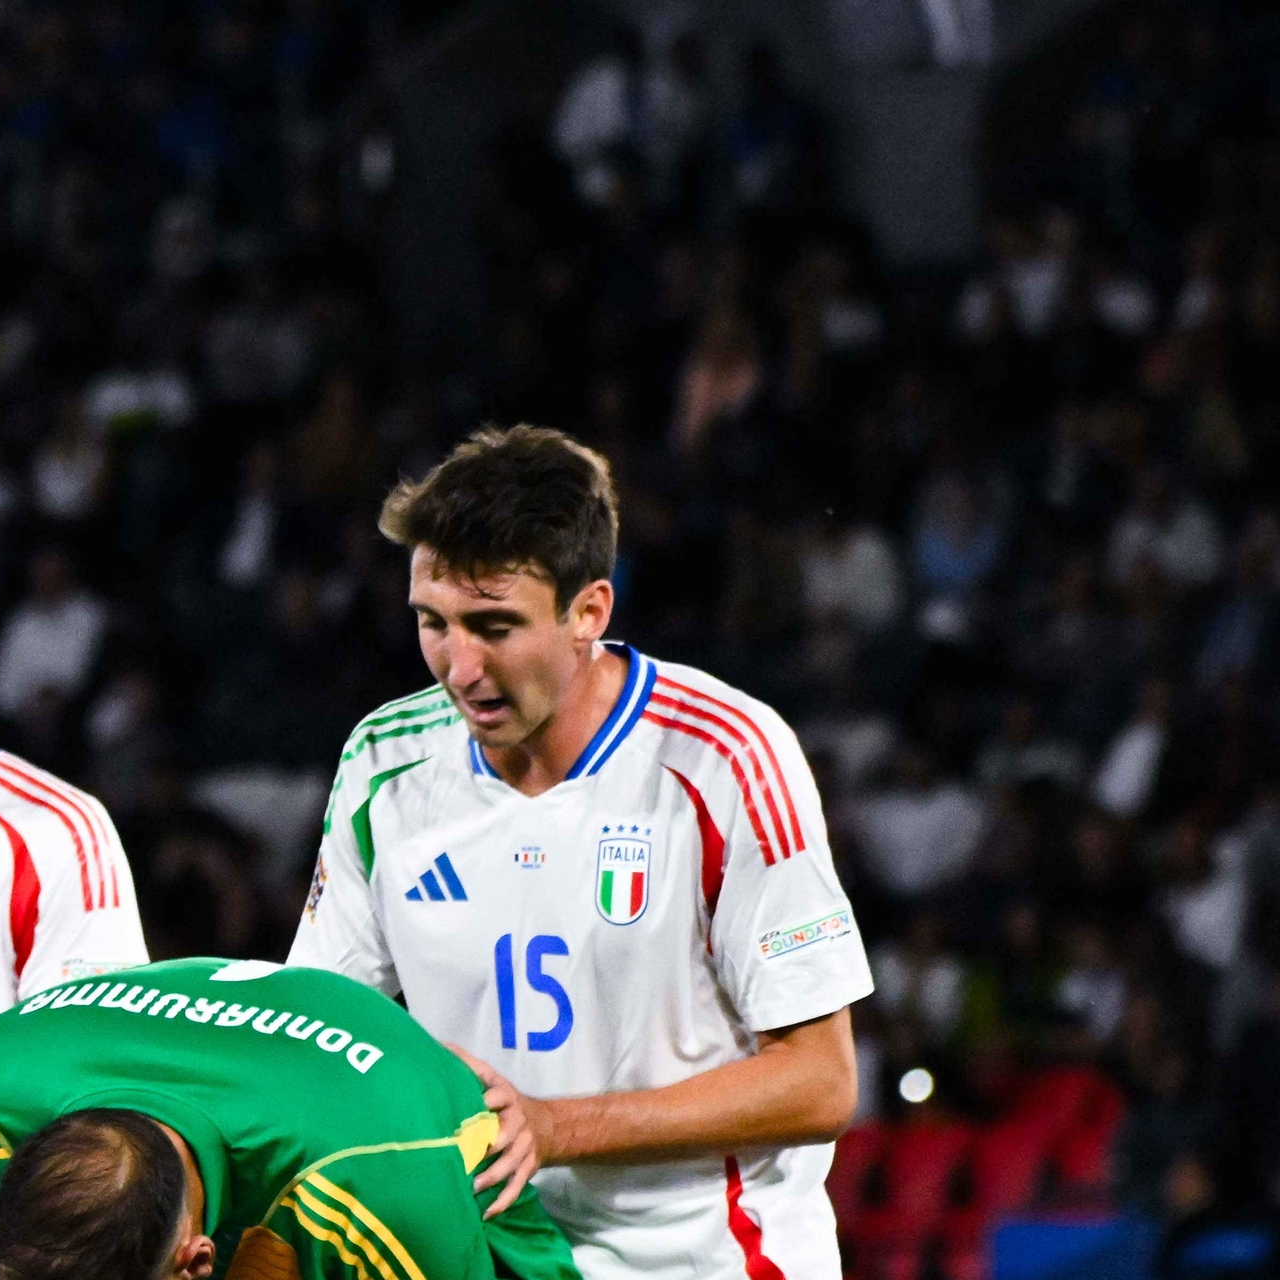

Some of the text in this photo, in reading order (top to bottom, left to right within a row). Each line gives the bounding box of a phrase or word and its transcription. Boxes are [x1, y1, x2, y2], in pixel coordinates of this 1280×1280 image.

[602, 846, 646, 863] ITALIA
[761, 914, 850, 955] FOUNDATION
[494, 933, 574, 1052] 15
